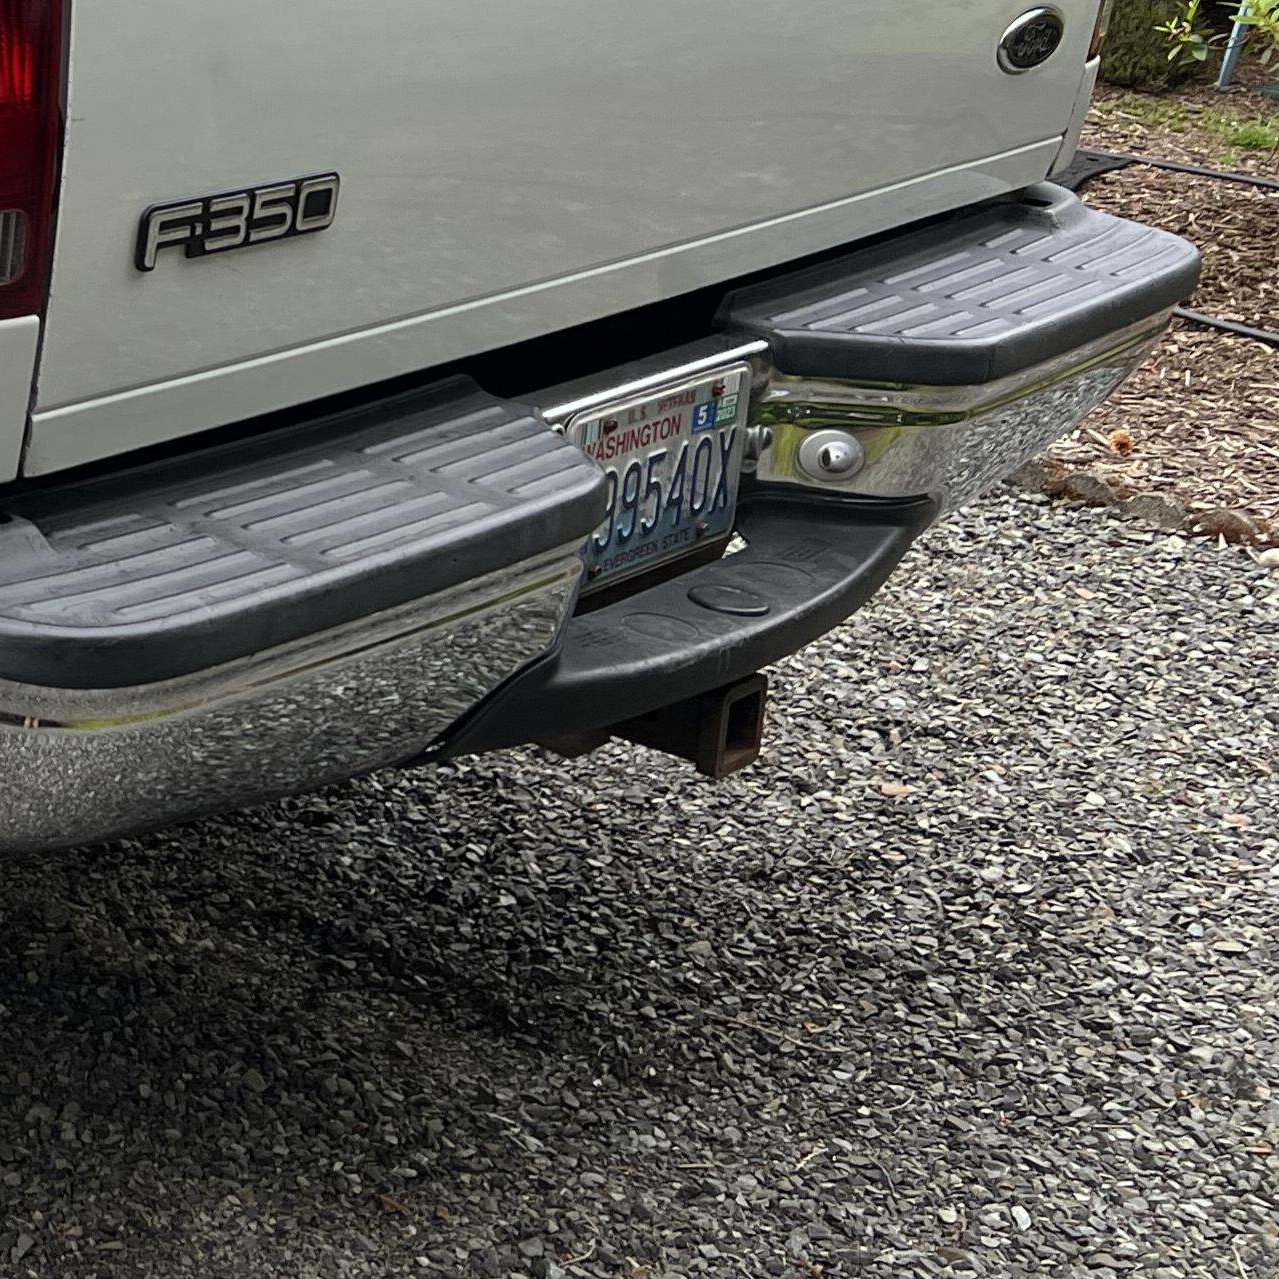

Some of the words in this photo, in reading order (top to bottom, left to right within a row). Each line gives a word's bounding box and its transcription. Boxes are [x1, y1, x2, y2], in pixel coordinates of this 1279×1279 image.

[582, 413, 681, 461] WASHINGTON
[697, 405, 708, 425] 5
[579, 425, 738, 554] 99540X
[603, 540, 658, 572] EVERGREEN
[662, 528, 691, 549] STATE
